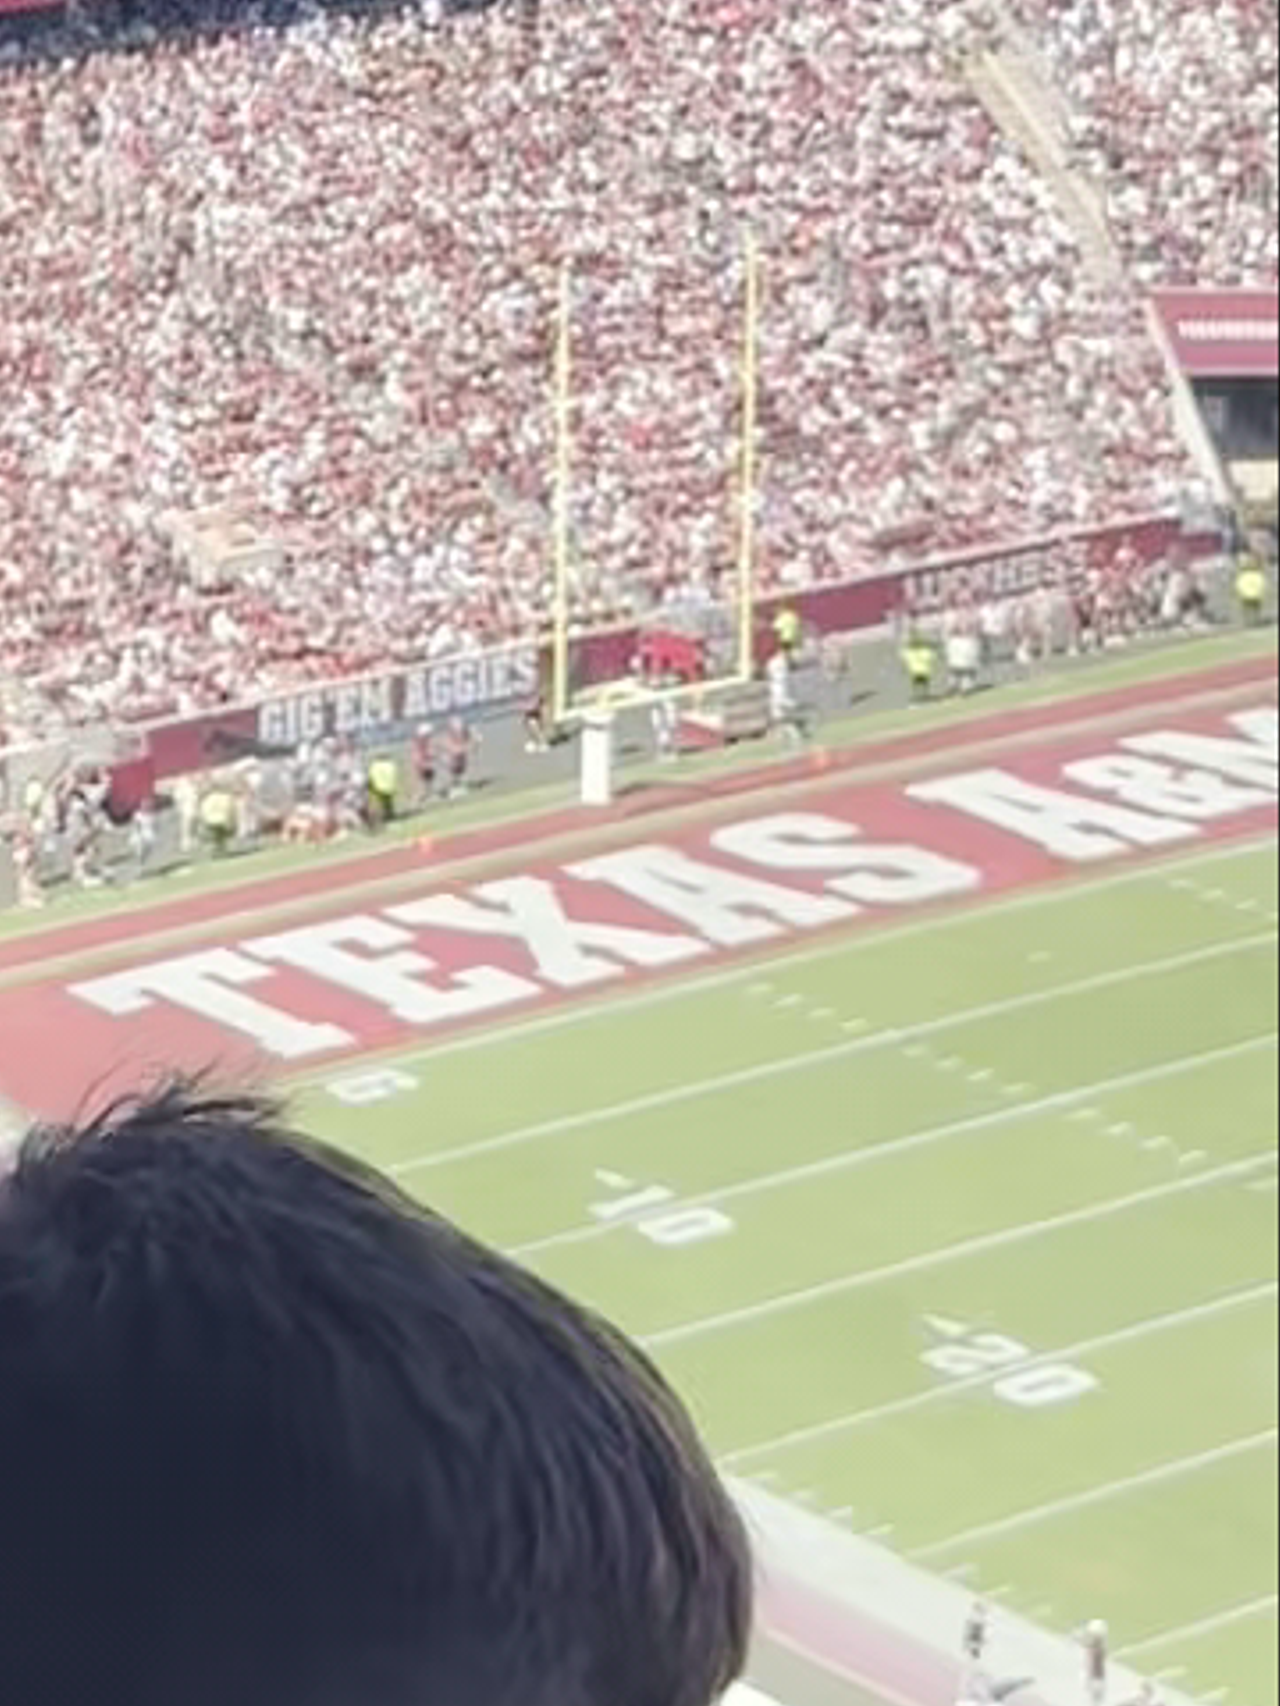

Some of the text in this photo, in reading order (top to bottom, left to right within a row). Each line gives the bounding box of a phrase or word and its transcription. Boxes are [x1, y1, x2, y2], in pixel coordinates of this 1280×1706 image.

[258, 694, 324, 745] GIG
[401, 650, 538, 718] AGGIES
[66, 812, 982, 1060] TEXAS
[587, 1184, 737, 1245] 10
[919, 1333, 1101, 1408] 20
